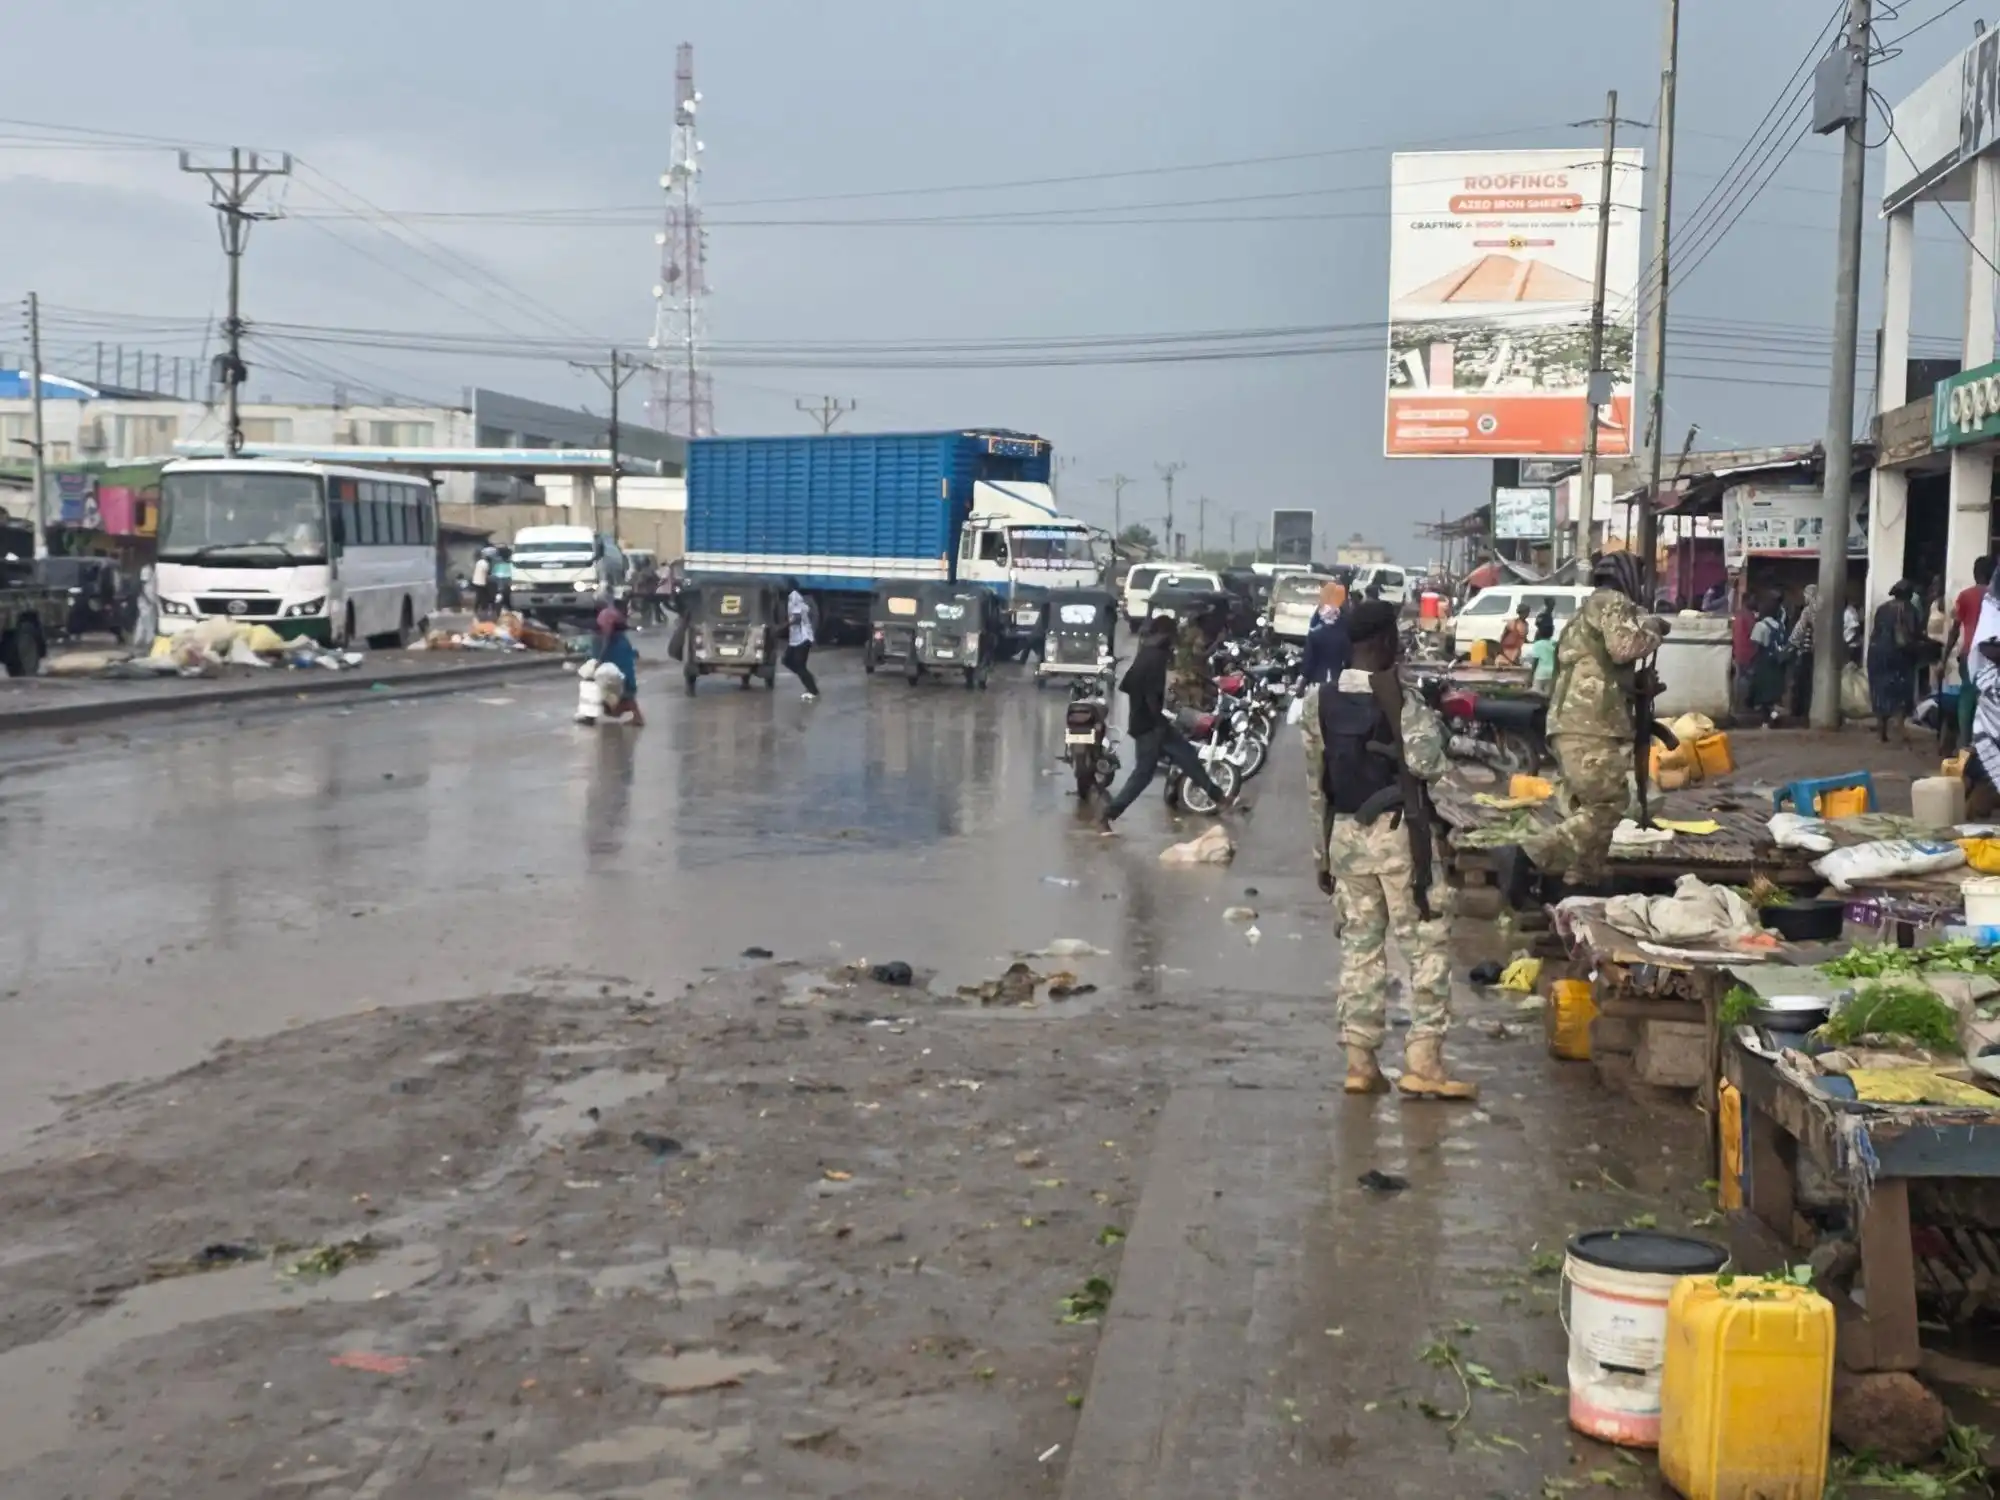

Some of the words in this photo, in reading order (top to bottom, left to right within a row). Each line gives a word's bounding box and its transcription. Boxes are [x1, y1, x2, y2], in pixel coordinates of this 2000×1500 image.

[1464, 174, 1568, 190] ROOFINGS
[1494, 199, 1524, 208] IRON
[1410, 221, 1462, 230] CRAFTING
